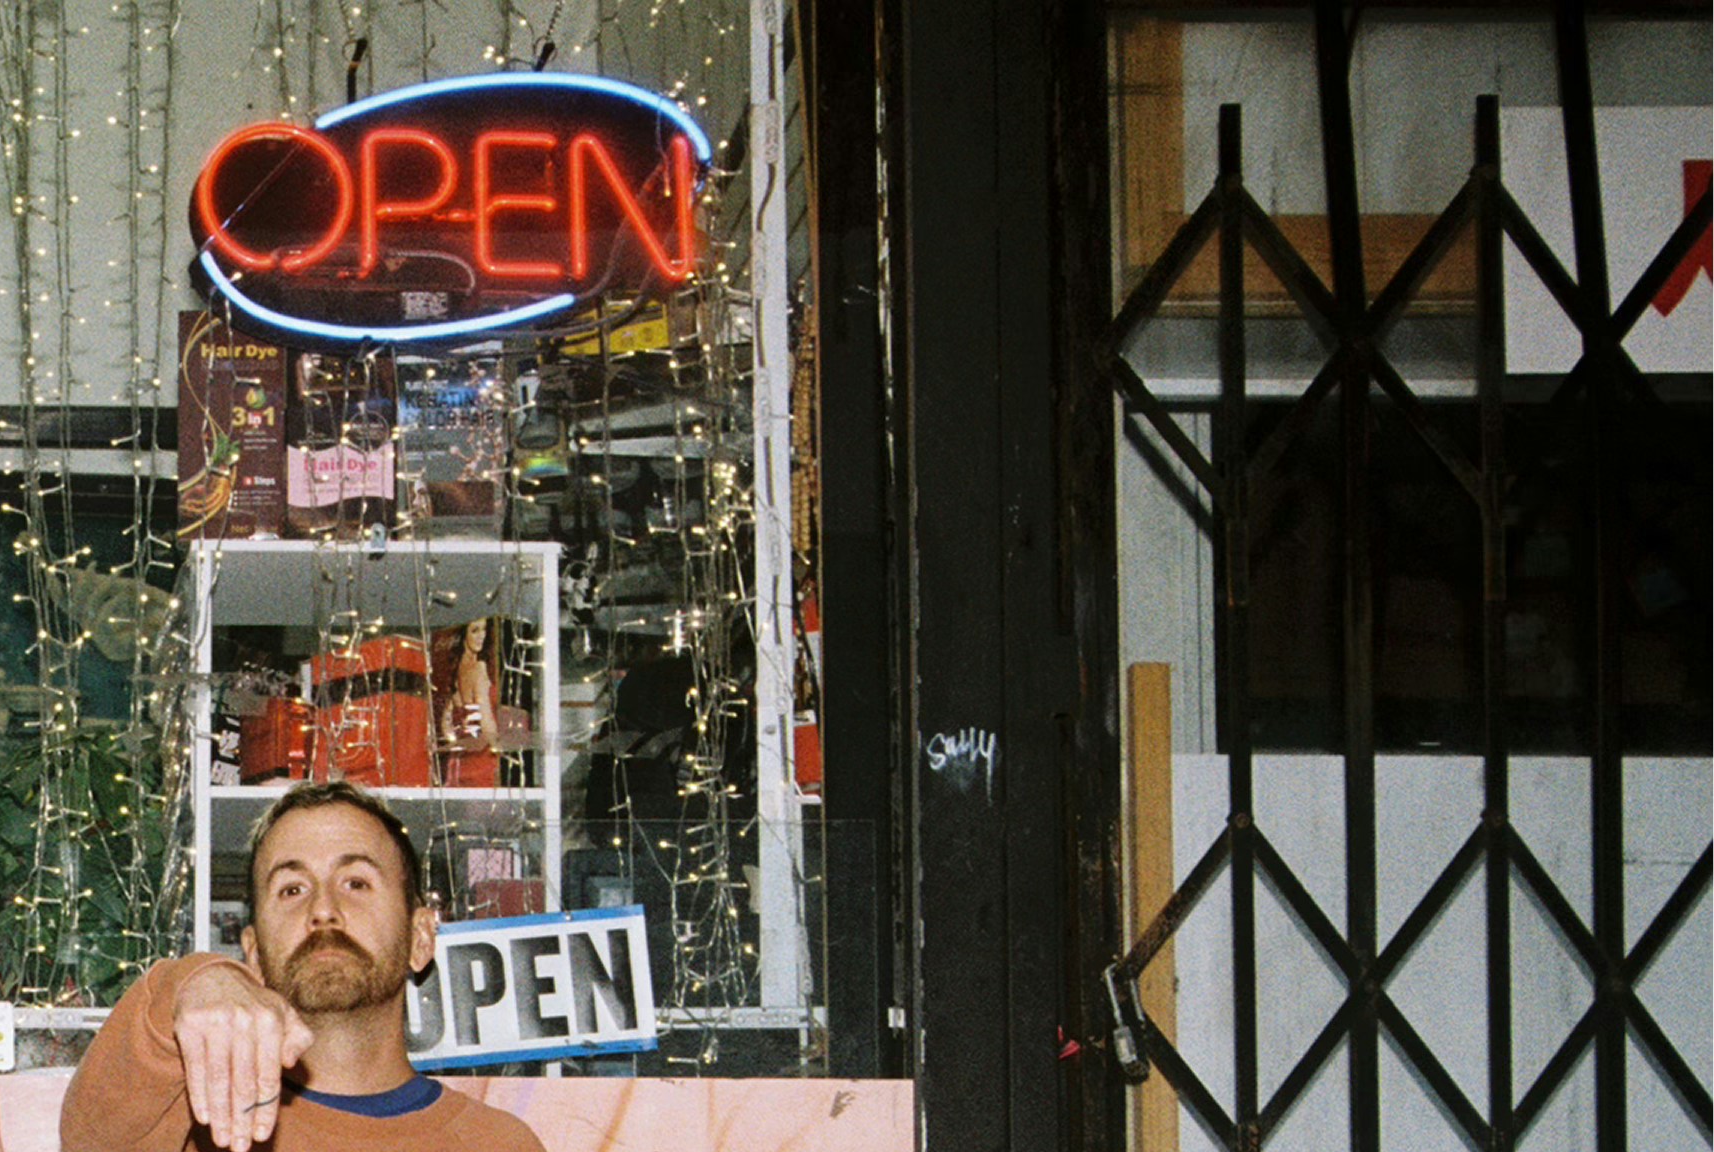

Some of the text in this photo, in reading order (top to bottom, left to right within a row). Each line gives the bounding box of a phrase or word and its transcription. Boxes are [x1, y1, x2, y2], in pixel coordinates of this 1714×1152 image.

[197, 120, 698, 283] OPEN
[245, 344, 278, 360] Dye
[347, 458, 378, 473] Dye
